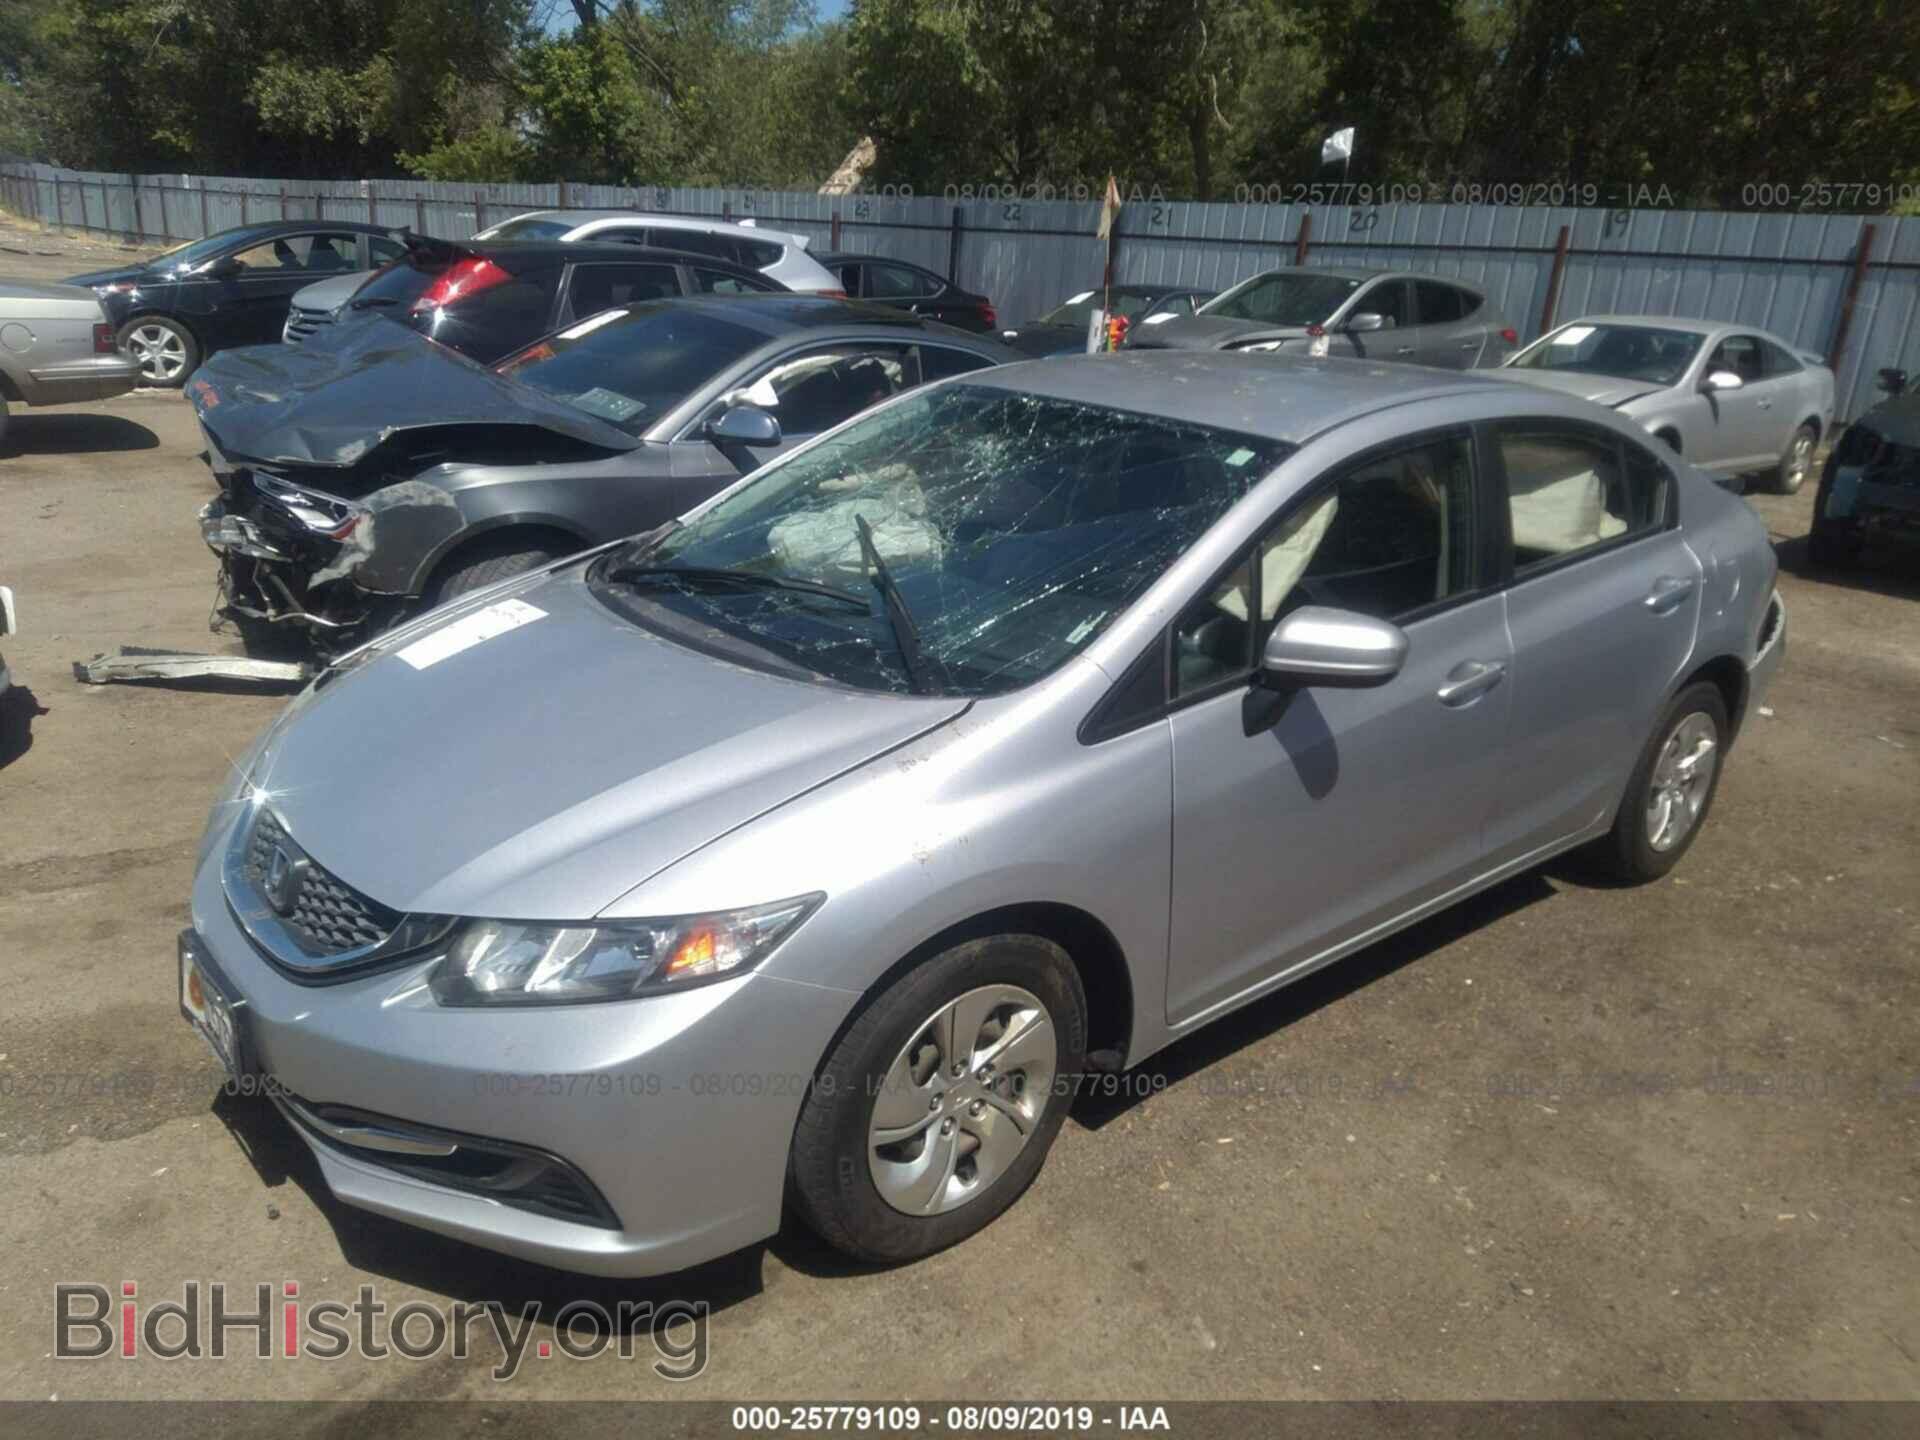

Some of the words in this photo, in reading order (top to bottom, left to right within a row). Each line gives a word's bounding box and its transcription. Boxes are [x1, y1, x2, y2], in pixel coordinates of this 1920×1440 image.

[1151, 207, 1174, 227] 21
[1350, 210, 1379, 232] 20
[1604, 209, 1632, 239] 19
